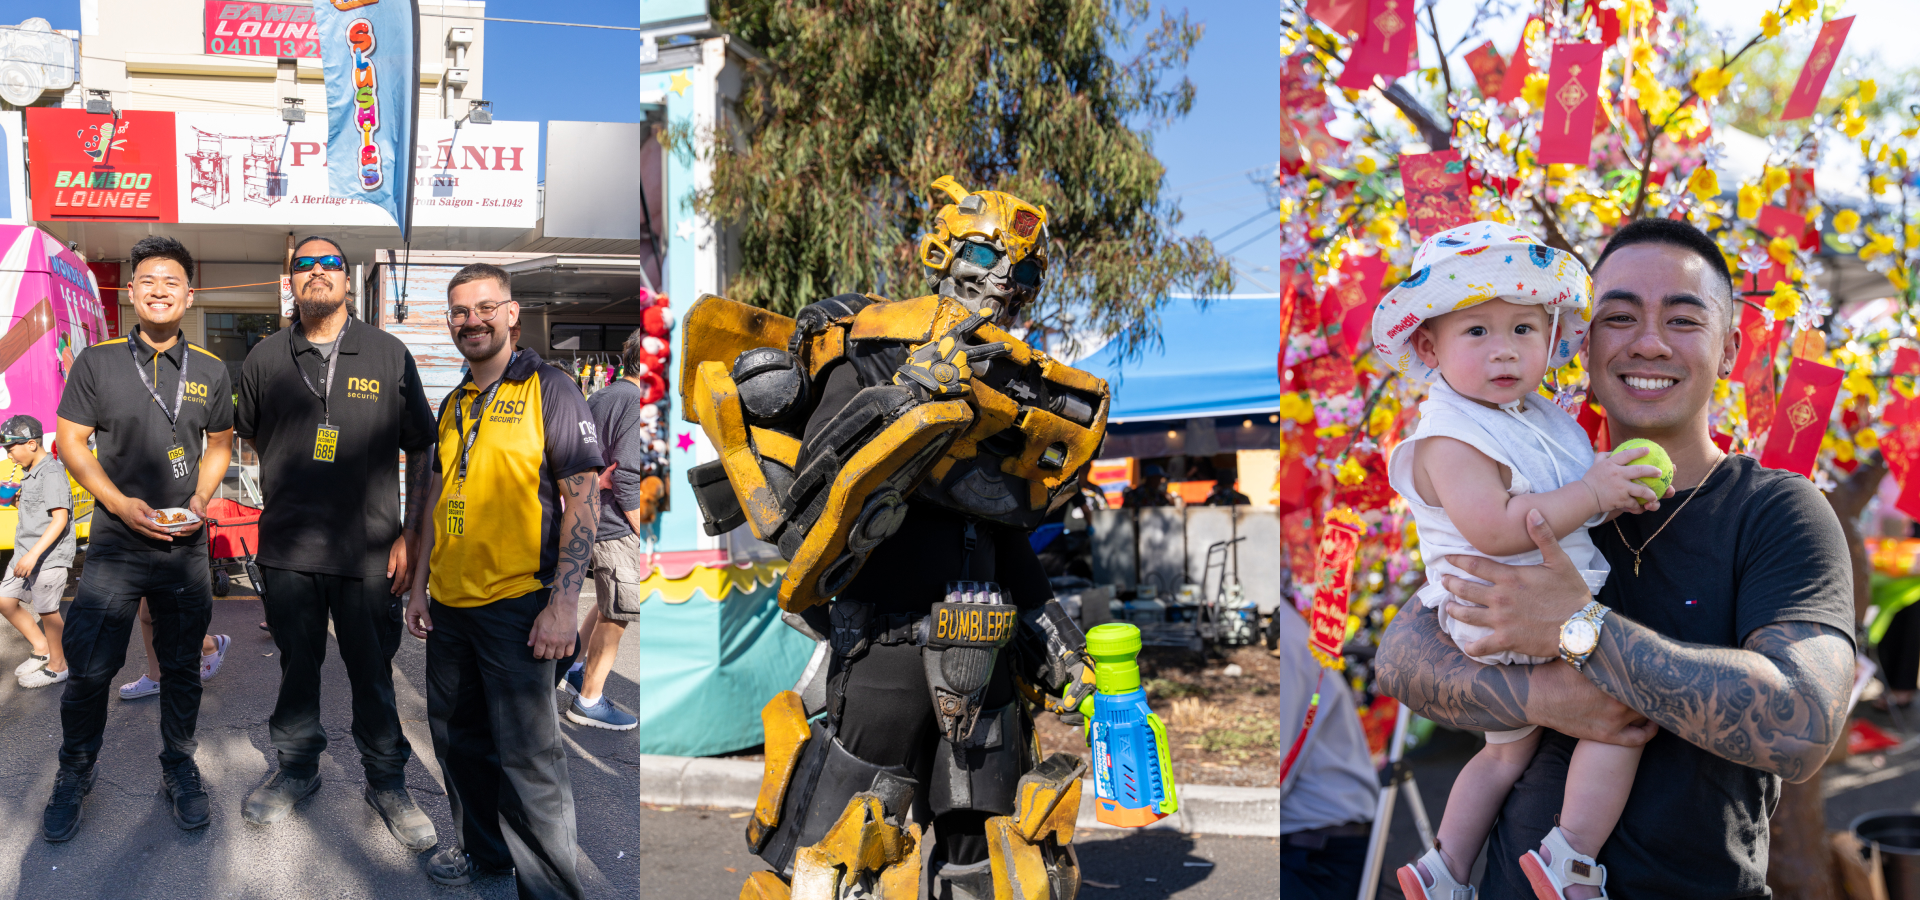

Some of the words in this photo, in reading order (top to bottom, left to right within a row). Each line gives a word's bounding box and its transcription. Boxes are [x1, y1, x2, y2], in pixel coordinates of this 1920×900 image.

[219, 5, 317, 23] BAMB
[211, 37, 260, 54] 0411
[273, 40, 296, 56] 13
[305, 41, 322, 57] 2
[349, 22, 380, 186] SLUSHIES
[54, 171, 152, 189] BAMBOO
[54, 191, 152, 208] LOUNGE
[290, 195, 299, 204] A
[302, 195, 347, 206] Heritage
[438, 197, 473, 208] Saigon
[482, 198, 523, 208] Est.1942
[59, 283, 78, 307] ICE
[347, 377, 380, 394] nsa
[183, 395, 207, 406] ecurity
[347, 391, 379, 402] security
[492, 399, 525, 415] nsa
[489, 415, 522, 424] SECURITY
[317, 436, 336, 444] SECURITY
[318, 429, 337, 439] nsa
[169, 448, 184, 459] nsa
[315, 443, 335, 460] 685
[172, 460, 189, 479] 531
[448, 500, 465, 510] nsa
[447, 515, 464, 534] 178
